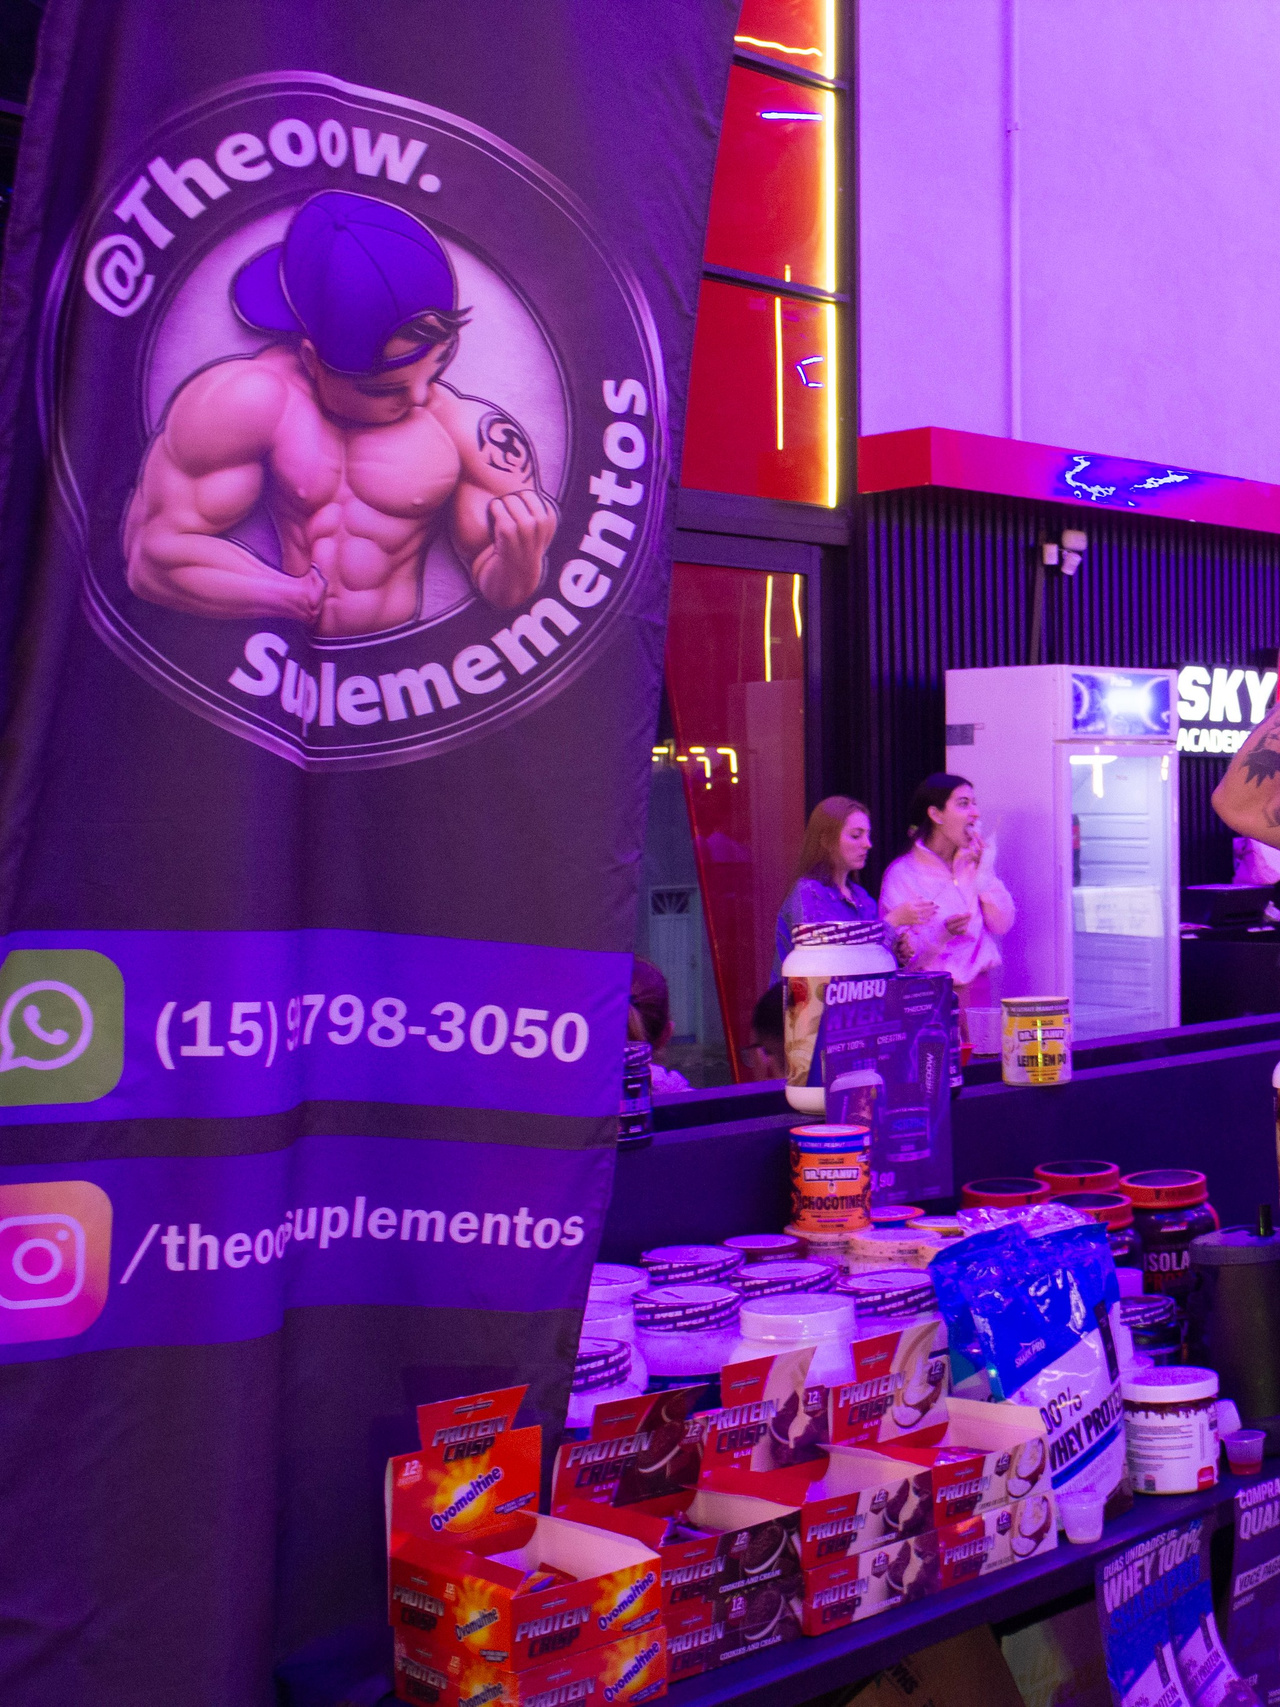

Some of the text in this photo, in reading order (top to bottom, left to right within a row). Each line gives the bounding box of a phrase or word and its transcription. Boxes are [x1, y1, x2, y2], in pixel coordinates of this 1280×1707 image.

[1176, 664, 1278, 724] SKY
[1176, 727, 1252, 753] ACADEM
[155, 1000, 279, 1070] (15)
[820, 1168, 858, 1180] PEANUT
[1143, 1250, 1190, 1272] ISOLA
[838, 1371, 906, 1408] PROTEIN
[707, 1398, 780, 1433] PROTEIN
[848, 1394, 895, 1426] CRISP
[1039, 1386, 1083, 1435] 00%
[431, 1414, 509, 1447] PROTEIN
[716, 1422, 768, 1454] CRISP
[443, 1435, 496, 1463] CRISP
[565, 1430, 656, 1469] PROTEIN
[575, 1453, 638, 1488] CRISP
[430, 1467, 503, 1531] Ovomaltine
[936, 1475, 992, 1503] PROTEIN
[806, 1512, 868, 1543] PROTEIN
[943, 1534, 995, 1566] PROTEIN
[660, 1554, 727, 1588] PROTEIN
[1103, 1529, 1203, 1614] WHEY 100%
[393, 1584, 445, 1617] PROTEIN
[598, 1571, 657, 1631] Ovomaltine
[812, 1575, 870, 1610] PROTEIN
[455, 1607, 499, 1641] Ovomaltine
[515, 1604, 592, 1642] PROTEIN
[396, 1656, 448, 1690] PROTEIN
[603, 1641, 661, 1702] Ovomaltine
